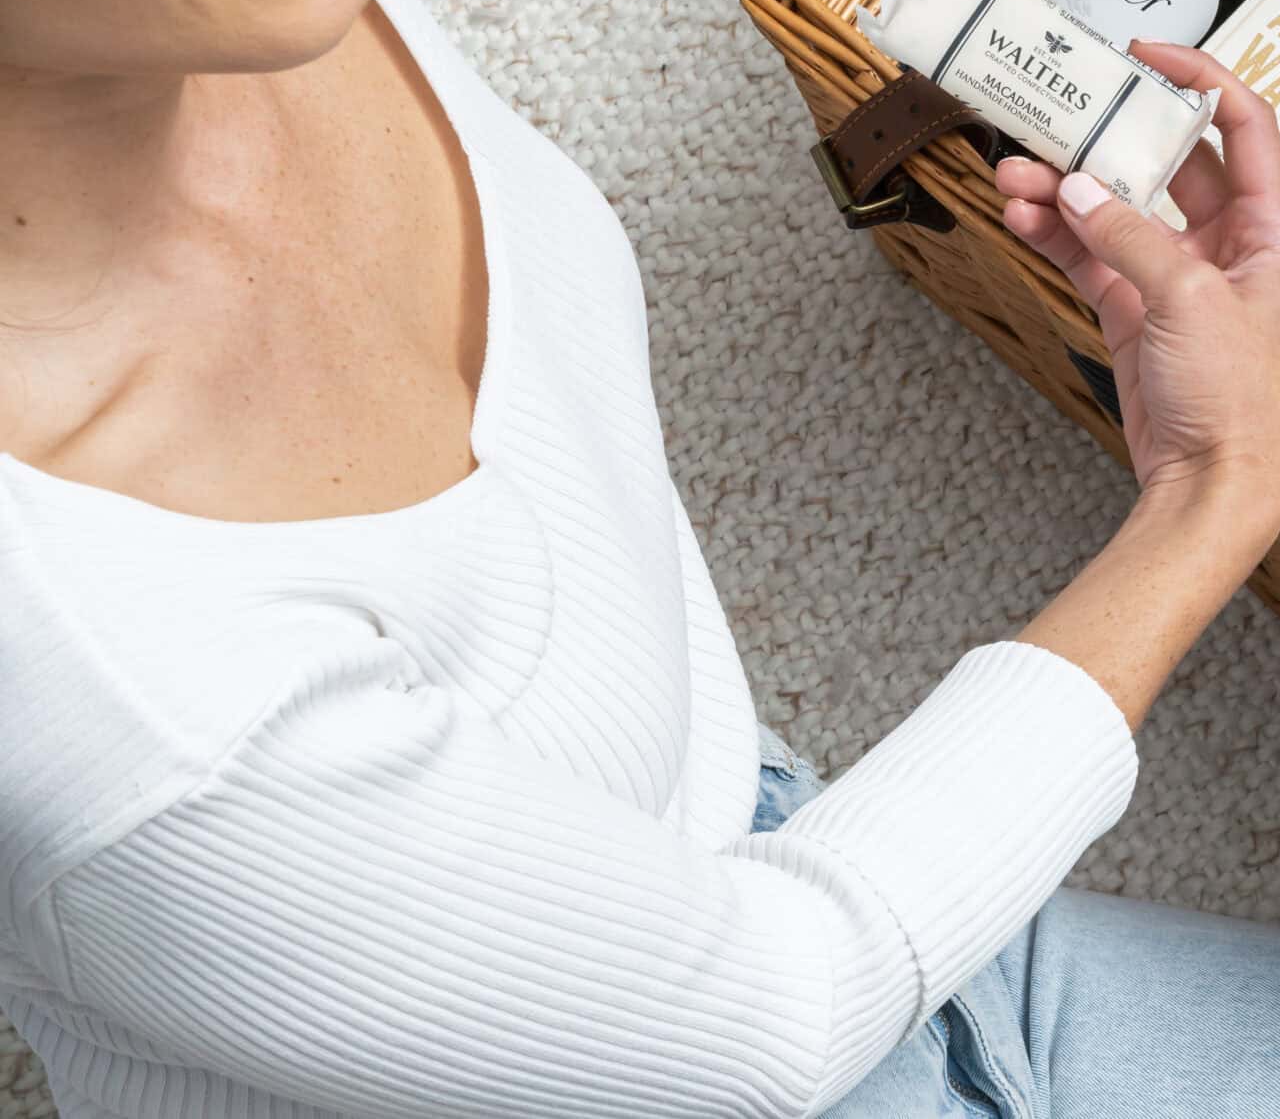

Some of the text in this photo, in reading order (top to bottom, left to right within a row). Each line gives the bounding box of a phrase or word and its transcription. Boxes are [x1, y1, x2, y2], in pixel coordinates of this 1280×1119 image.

[982, 73, 1053, 127] MACADAMIA
[984, 50, 1075, 116] CRAFTED CONFECTIONERY
[988, 28, 1092, 111] WALTERS
[955, 68, 1070, 151] HANDMADE HONEY NOUGAT
[1112, 177, 1131, 195] 50g
